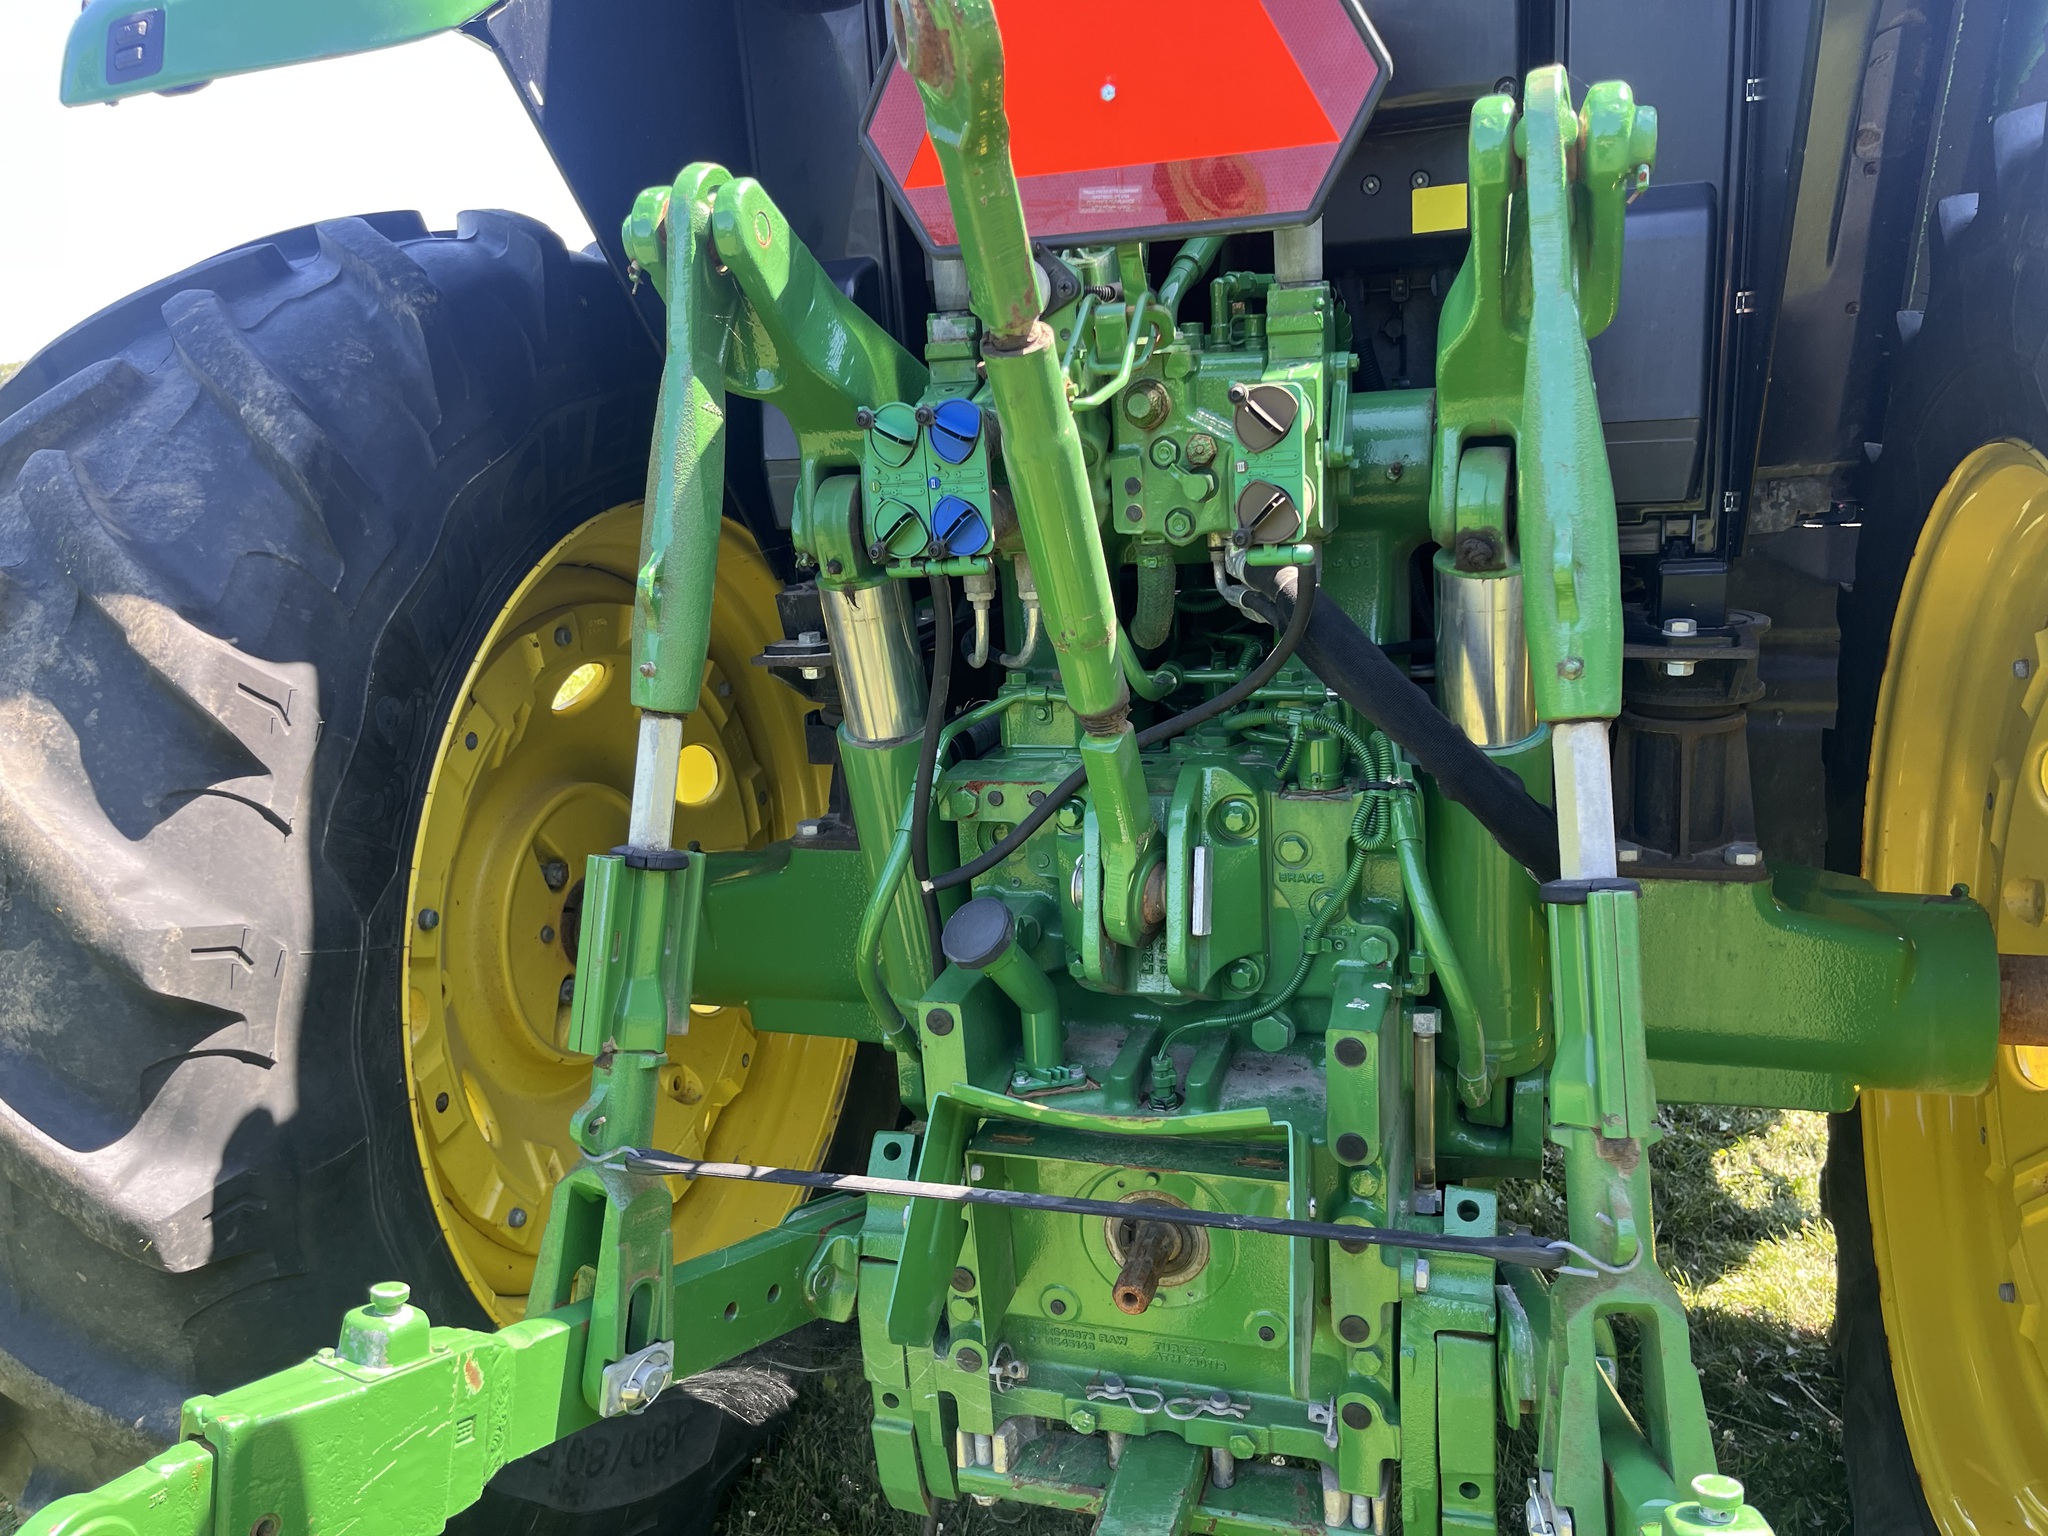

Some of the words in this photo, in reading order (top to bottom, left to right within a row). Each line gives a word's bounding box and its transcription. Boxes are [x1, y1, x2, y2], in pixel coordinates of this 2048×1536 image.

[1278, 872, 1325, 884] BRAKE
[1098, 1333, 1129, 1347] RAW
[1152, 1341, 1207, 1357] TURKEY
[1155, 1351, 1182, 1364] ATM
